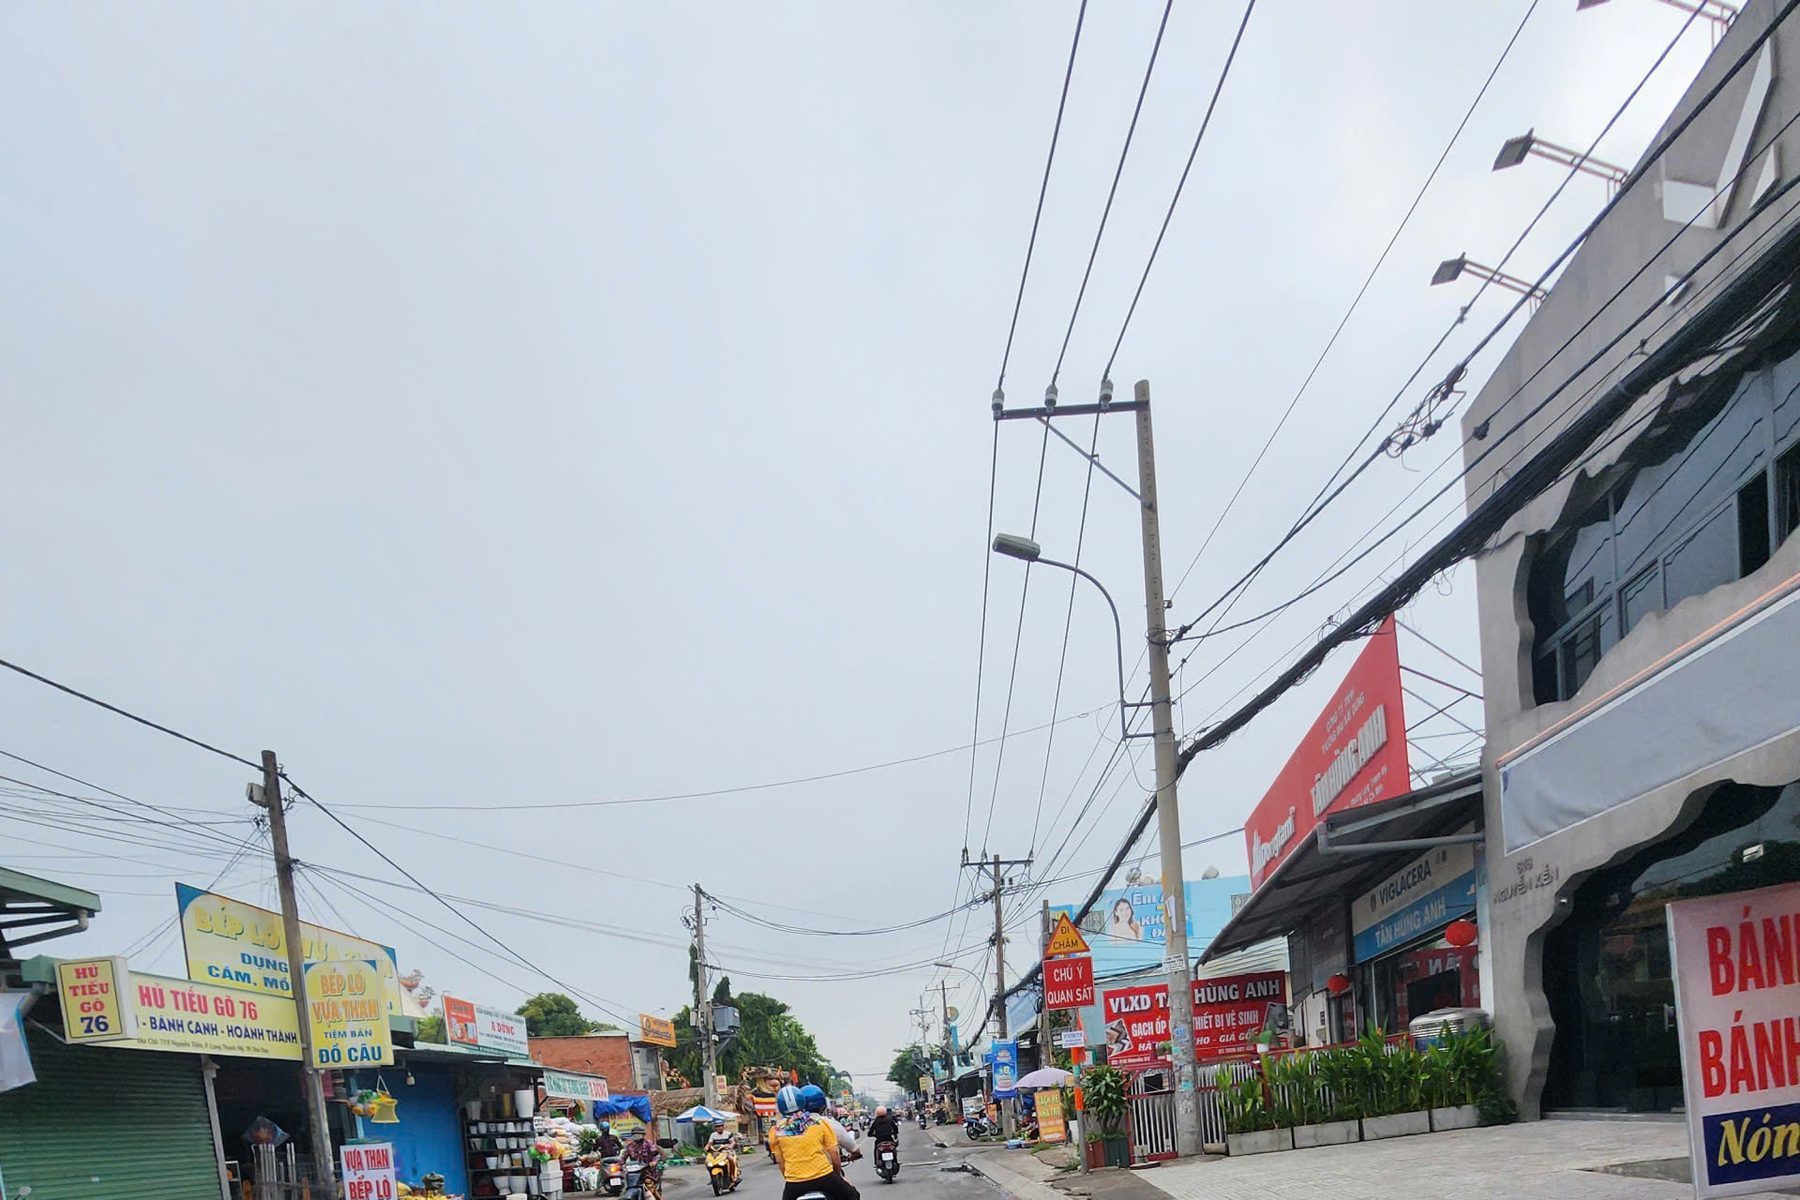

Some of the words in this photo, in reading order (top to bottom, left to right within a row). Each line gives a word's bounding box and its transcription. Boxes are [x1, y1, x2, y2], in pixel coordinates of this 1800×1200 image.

[1380, 860, 1432, 906] VIGLACERA
[1423, 896, 1447, 923] ANH
[1061, 926, 1070, 935] ĐI
[1707, 906, 1800, 997] BÁN
[320, 967, 346, 997] BẾP
[1053, 963, 1073, 982] CHÚ
[1076, 962, 1084, 980] Ý
[69, 980, 109, 997] TIẾU
[1047, 989, 1074, 1005] QUAN
[1075, 984, 1092, 1000] SÁT
[1109, 994, 1152, 1013] VLXD
[1194, 982, 1239, 1005] HÙNG
[1245, 979, 1280, 999] ANH
[138, 982, 166, 1009] HỦ
[169, 986, 209, 1014] TIẾU
[239, 1000, 258, 1020] 76
[341, 998, 380, 1022] THAN
[80, 1015, 109, 1034] 76
[188, 1021, 219, 1037] CANH
[1131, 1021, 1154, 1039] GẠCH
[1215, 1014, 1225, 1031] BỊ
[1225, 1009, 1236, 1029] VỆ
[1238, 1010, 1259, 1025] SINH
[1195, 1036, 1211, 1045] HO
[319, 1043, 342, 1064] ĐỒ
[347, 1043, 382, 1062] CÂU
[364, 1148, 390, 1170] THAN
[376, 1174, 392, 1200] LÒ
